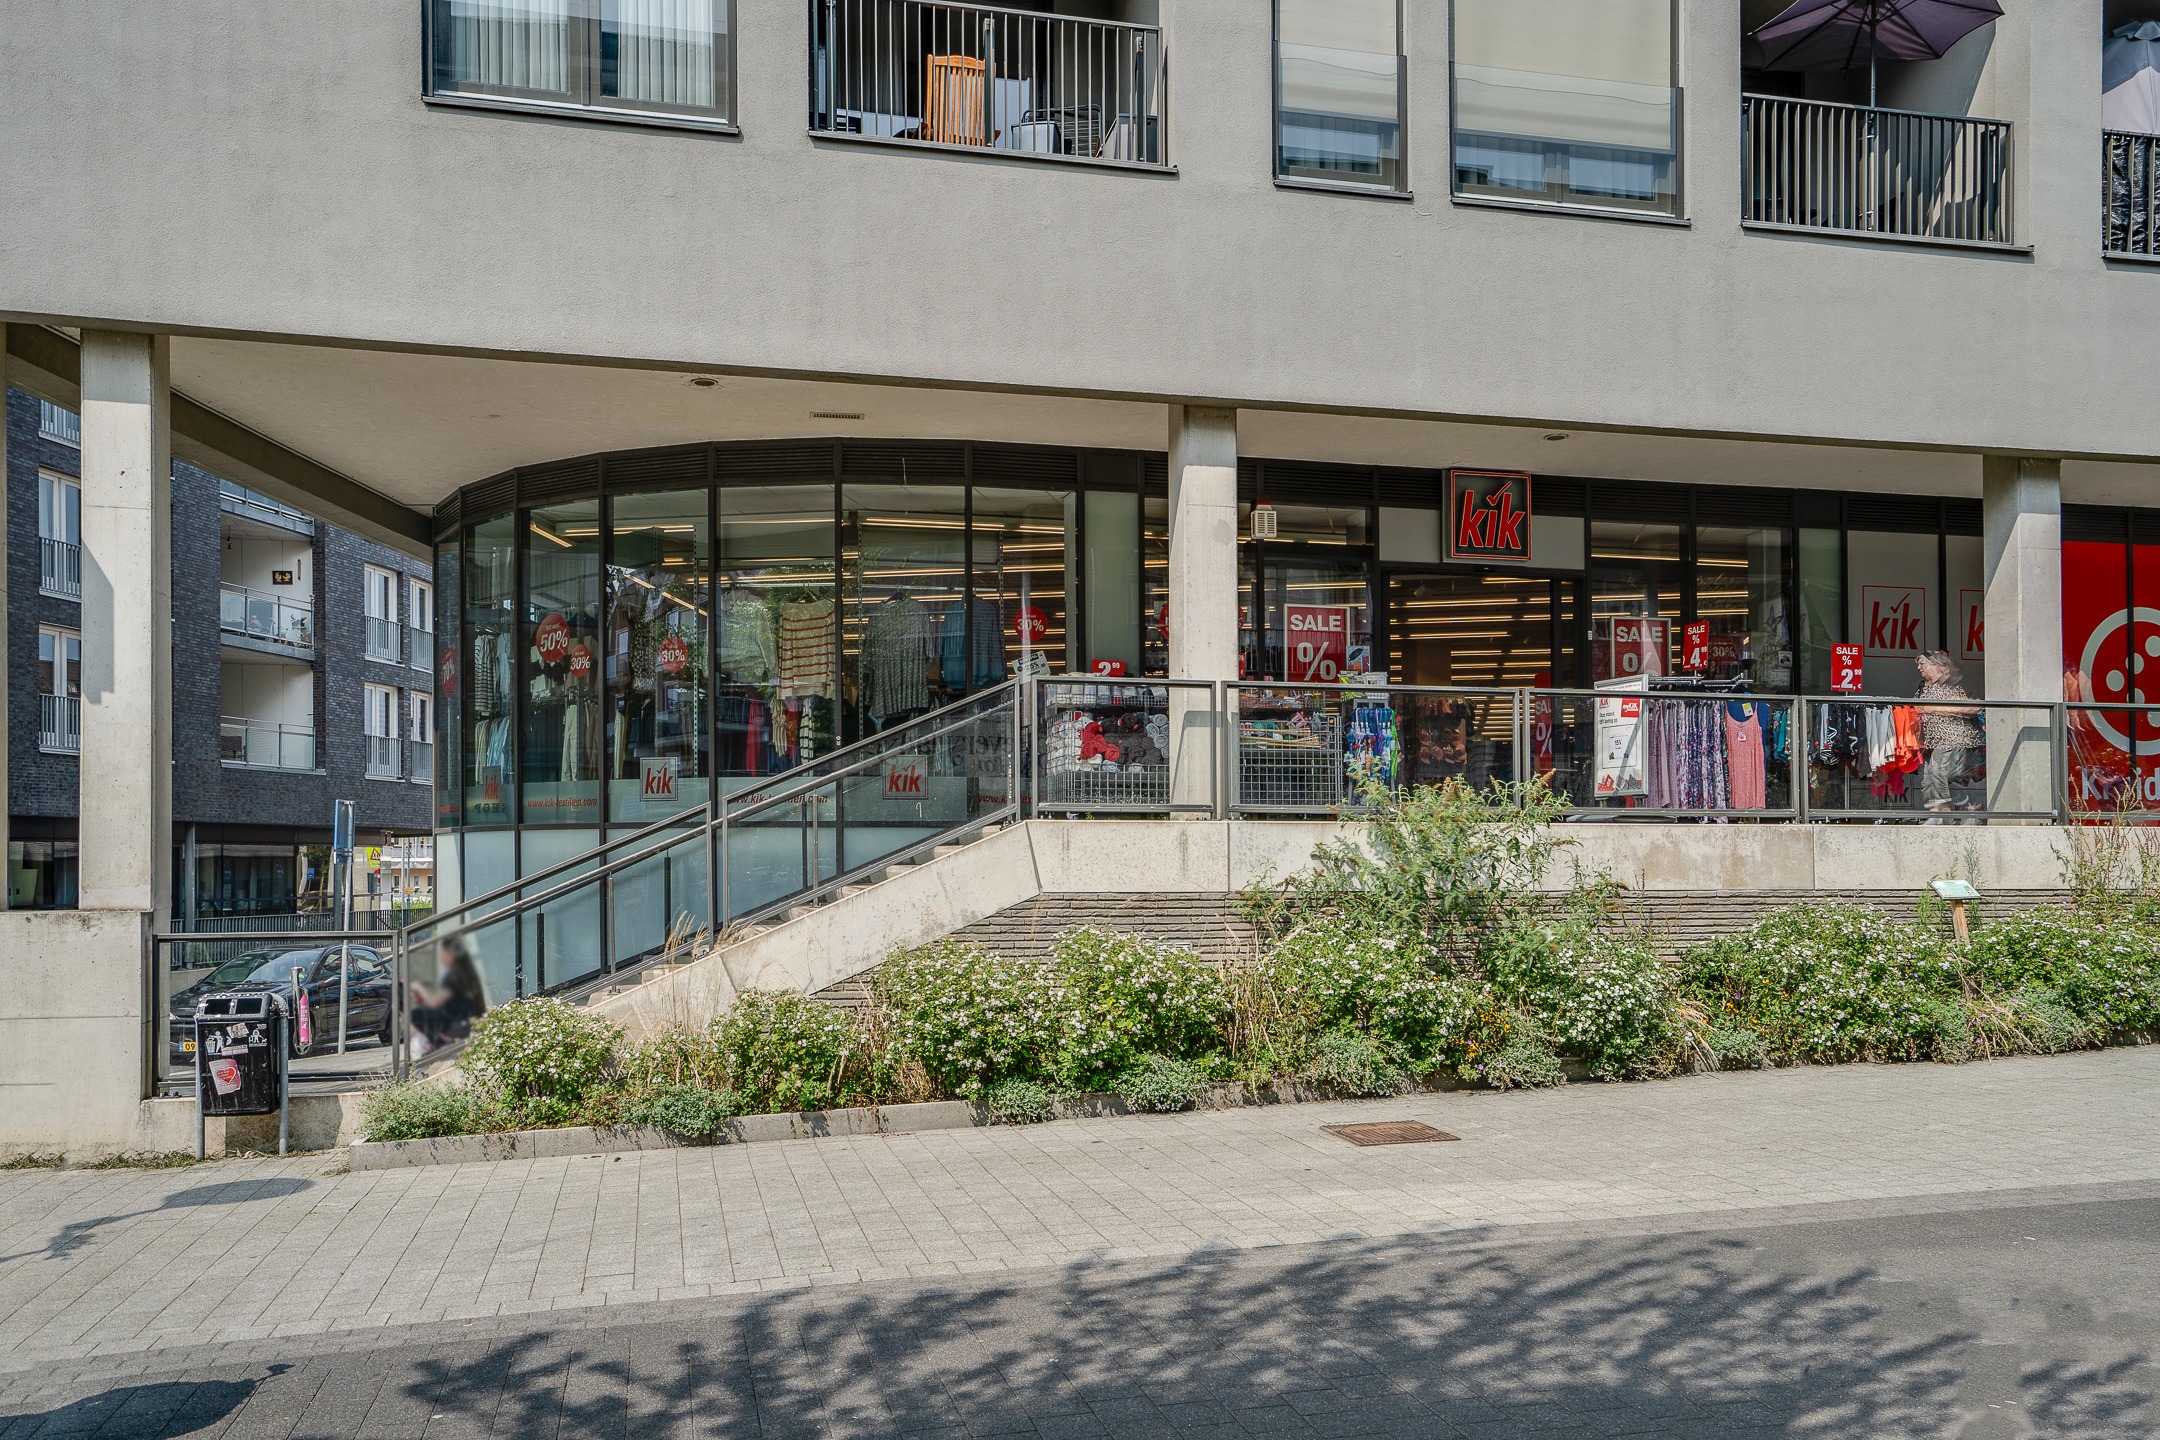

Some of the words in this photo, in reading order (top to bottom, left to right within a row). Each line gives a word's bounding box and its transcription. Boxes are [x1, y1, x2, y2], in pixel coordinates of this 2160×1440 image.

[1459, 481, 1525, 549] kik
[1017, 618, 1046, 632] 30%
[1290, 614, 1342, 631] SALE
[1869, 593, 1920, 649] kik
[1616, 626, 1663, 642] SALE
[1687, 625, 1705, 635] SALE
[540, 628, 568, 652] 50%
[1692, 634, 1700, 645] %
[662, 650, 685, 662] 30%
[1712, 646, 1735, 658] 30%
[1836, 647, 1858, 655] SALE
[570, 655, 591, 670] 30%
[1297, 641, 1337, 681] %
[1842, 655, 1852, 666] %
[645, 762, 673, 795] kik
[888, 760, 922, 792] kik
[484, 772, 499, 800] kik
